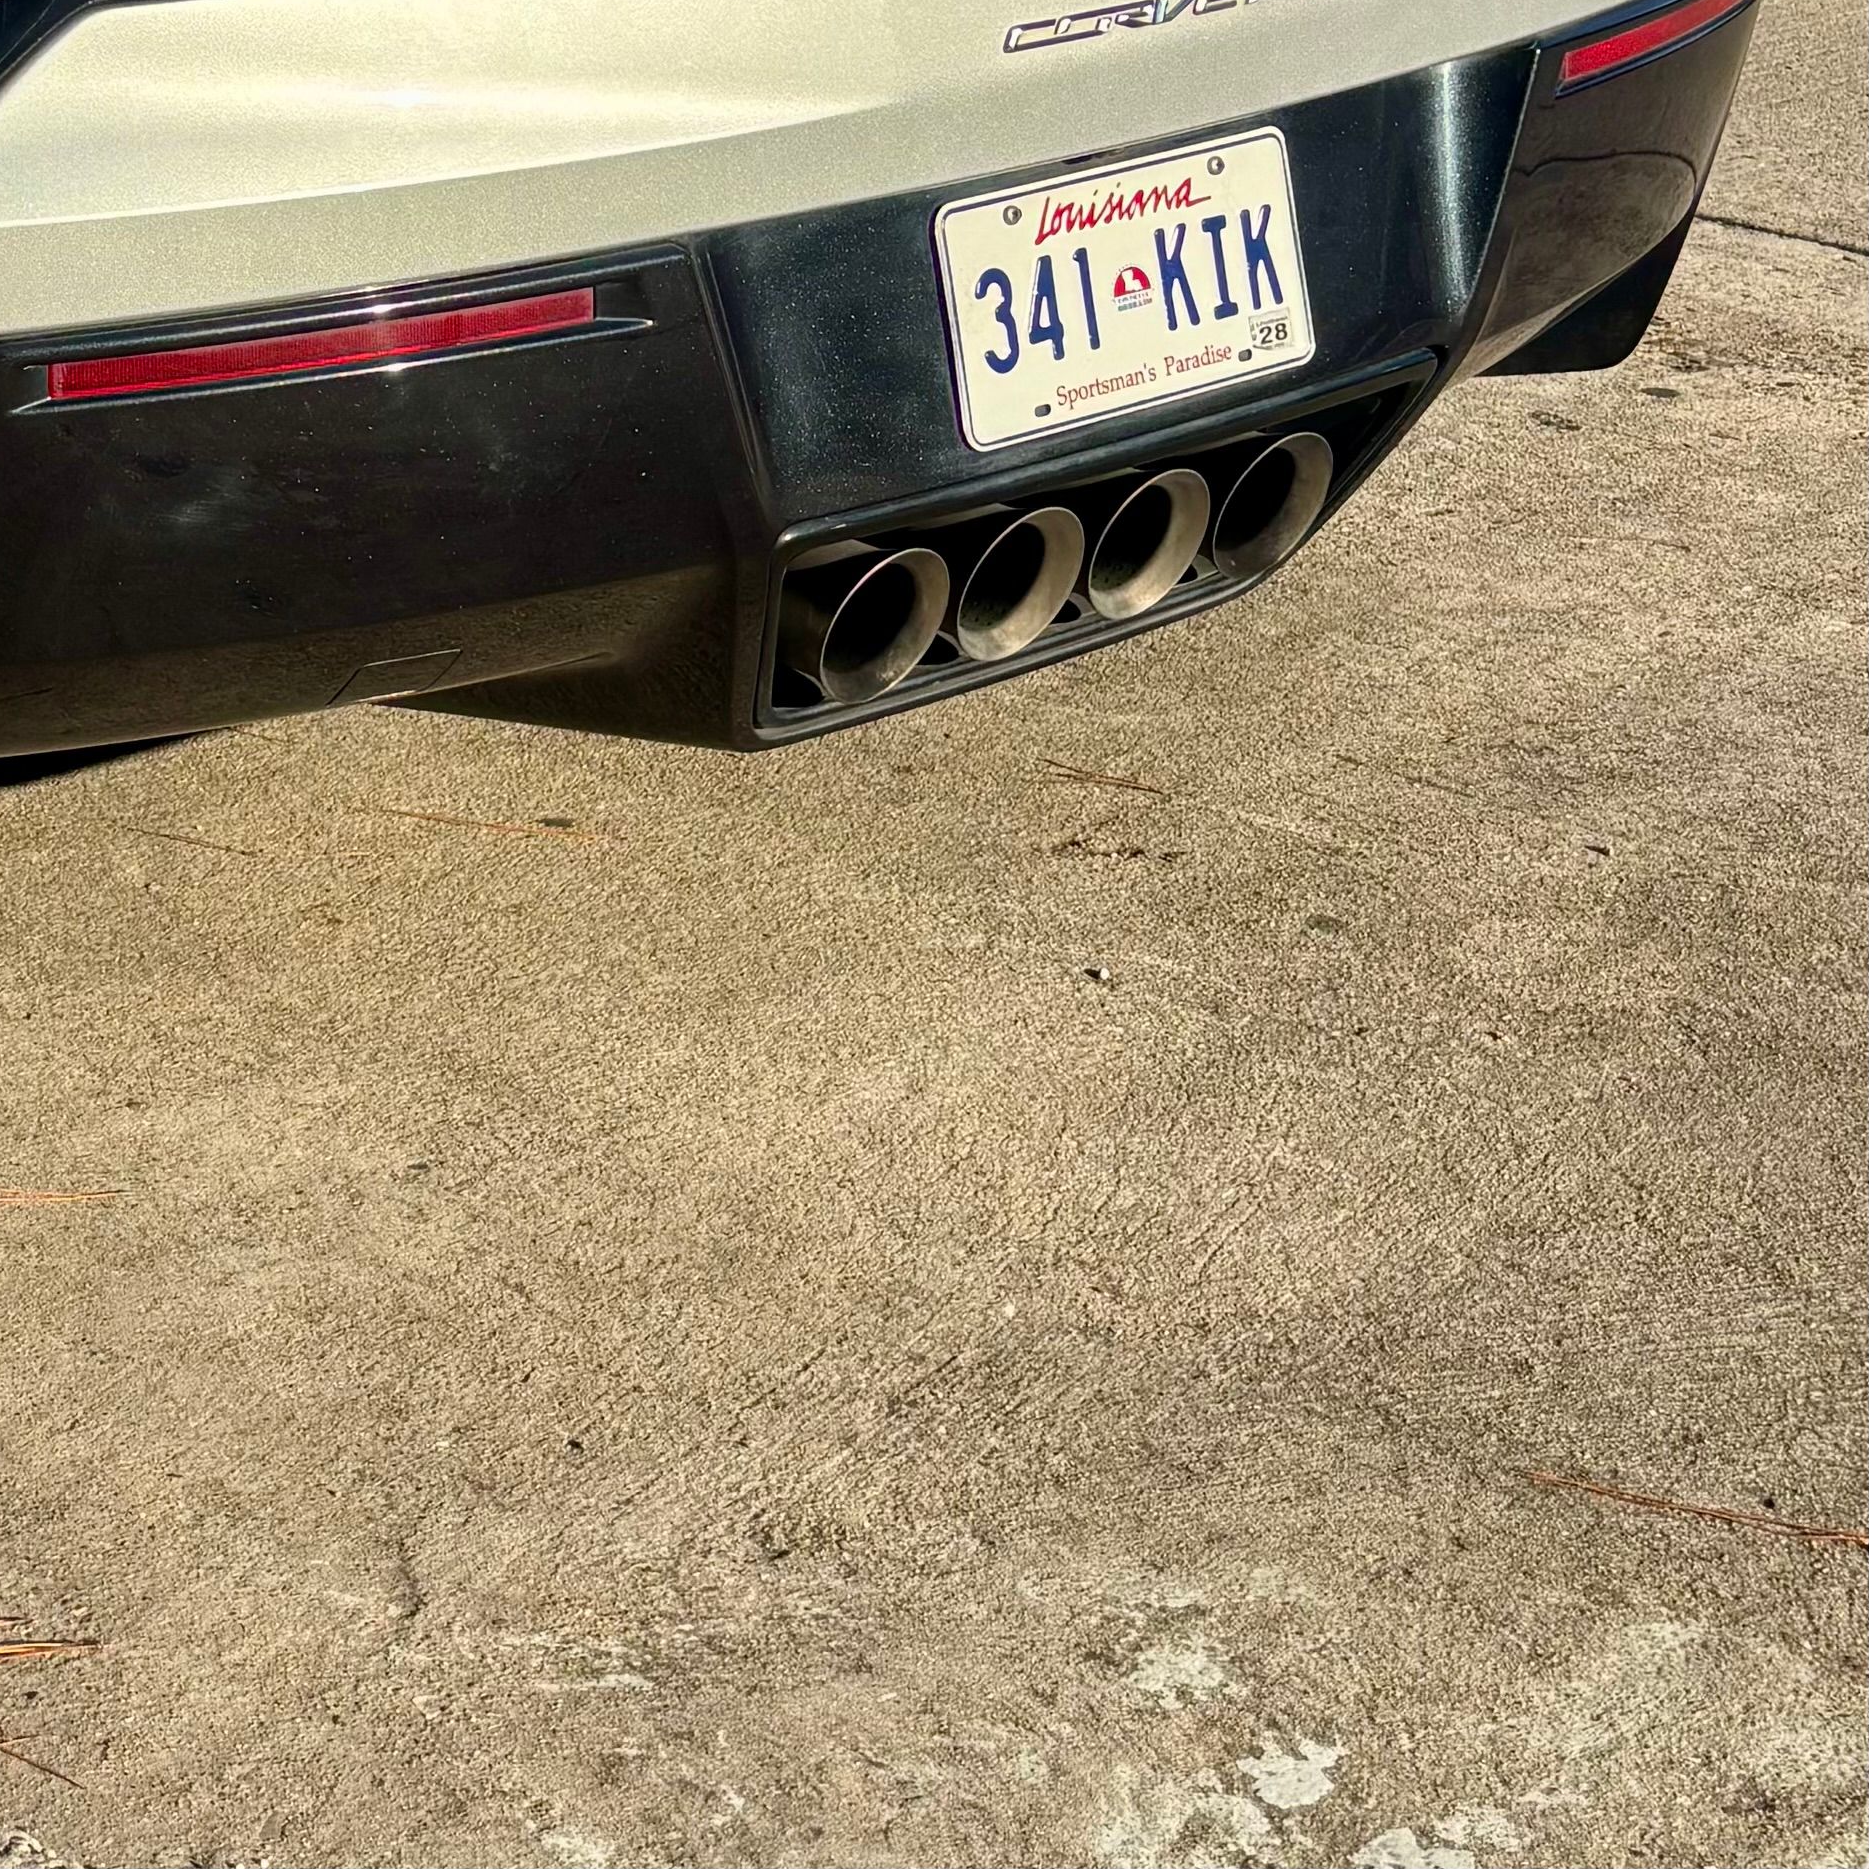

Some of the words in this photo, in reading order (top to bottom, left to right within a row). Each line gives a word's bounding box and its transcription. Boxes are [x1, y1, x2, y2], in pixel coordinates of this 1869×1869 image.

[1034, 177, 1212, 246] Louisiana
[974, 247, 1101, 375] 341
[1153, 203, 1284, 332] KIK
[1259, 322, 1289, 345] 28
[1055, 361, 1158, 411] Sportsman's
[1163, 343, 1233, 378] Paradise
